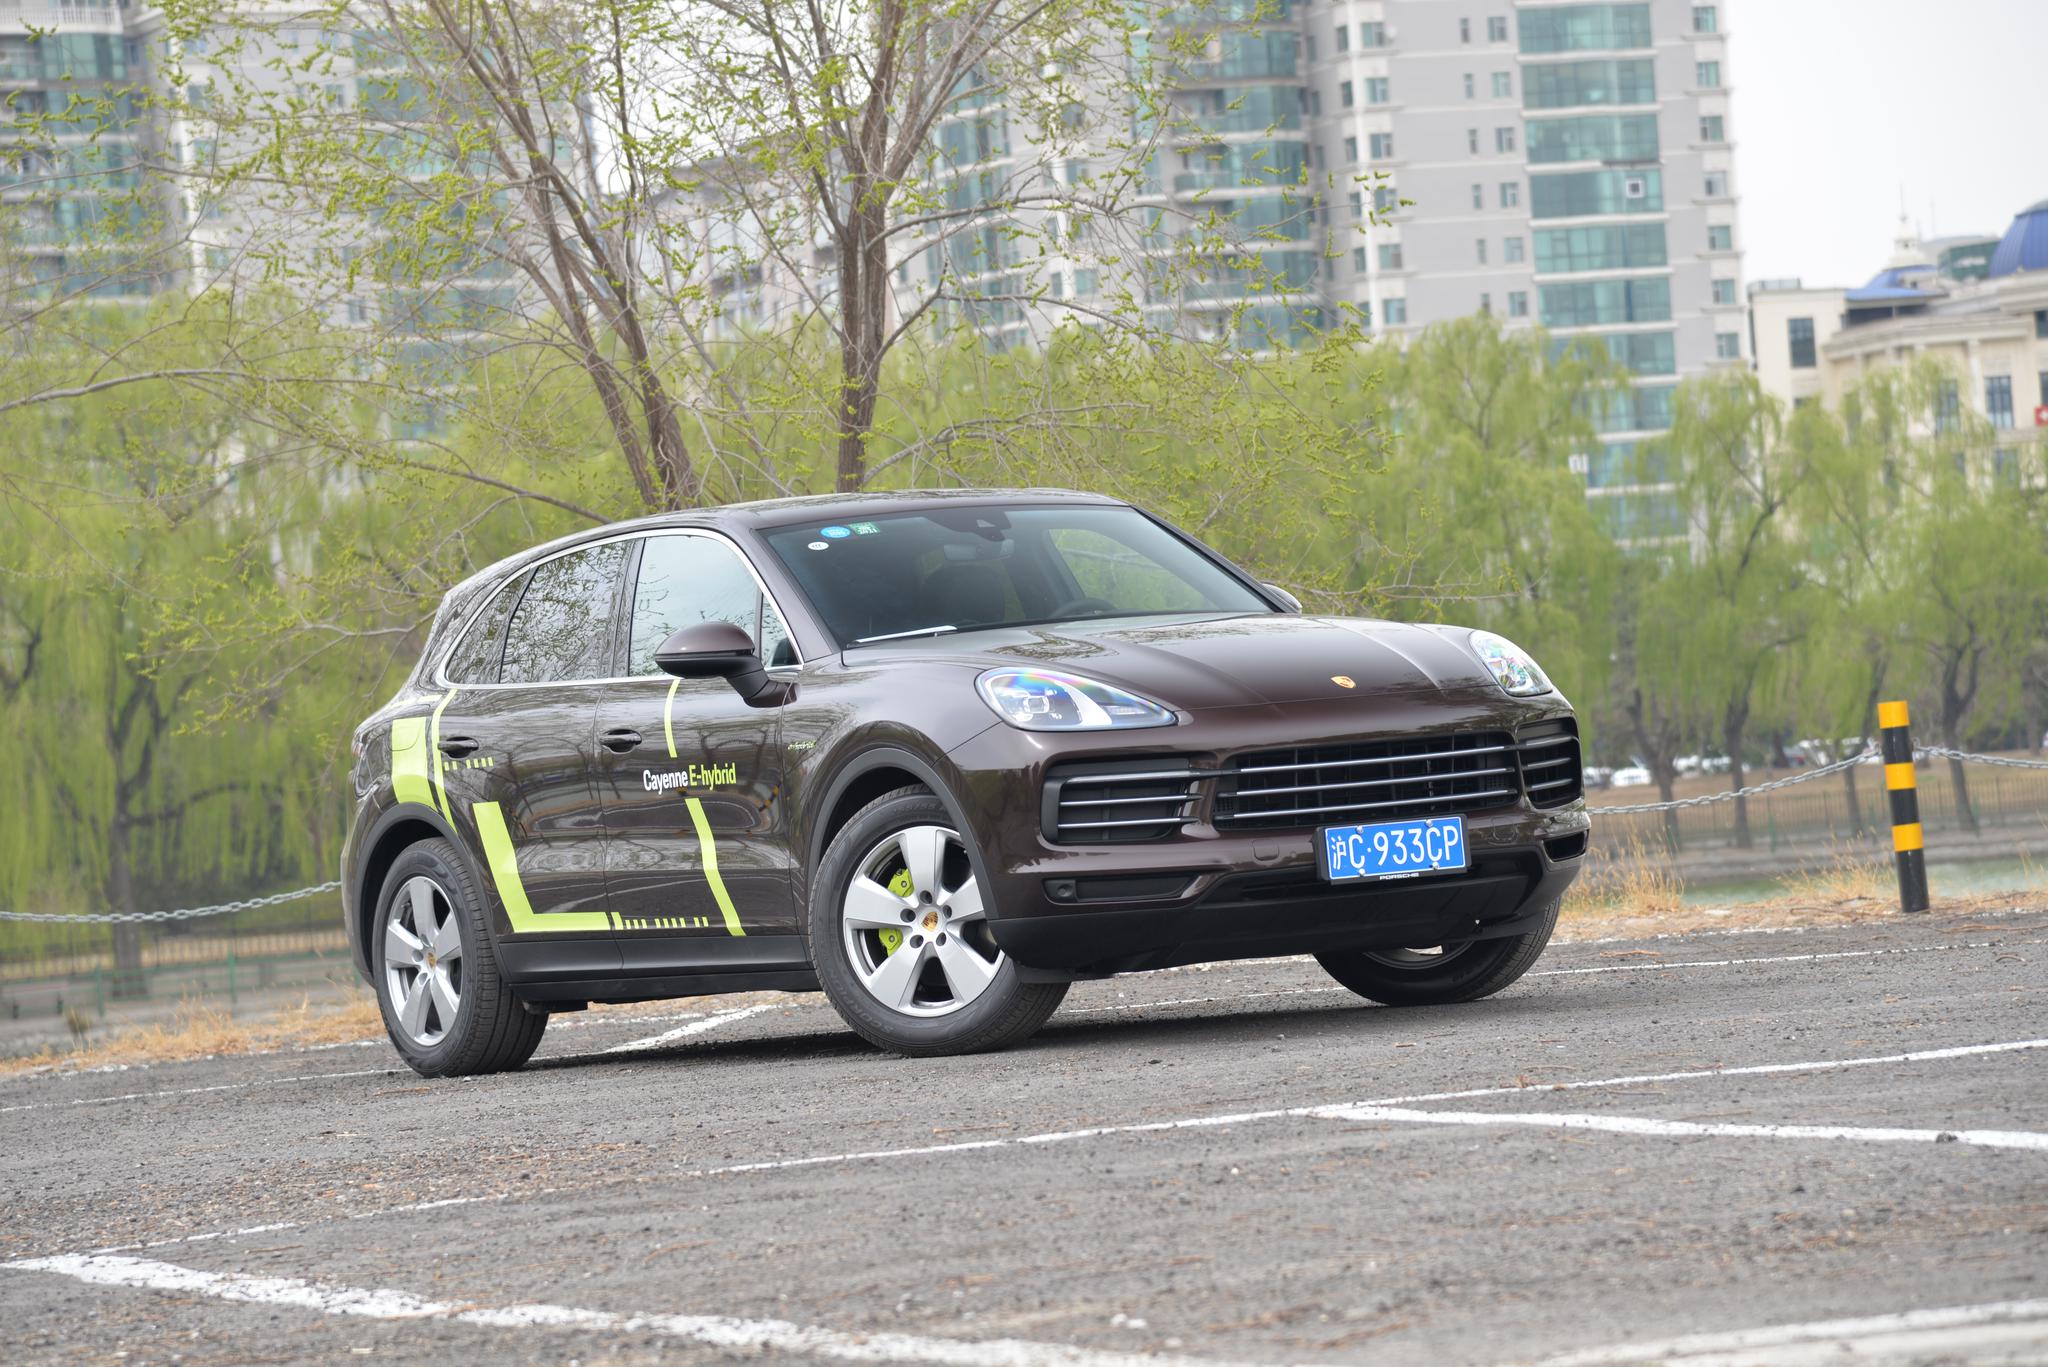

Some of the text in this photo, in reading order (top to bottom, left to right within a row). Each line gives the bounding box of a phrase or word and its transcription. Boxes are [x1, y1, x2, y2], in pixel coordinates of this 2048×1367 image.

[643, 762, 737, 795] Cayenne E-hybrid
[1379, 872, 1420, 881] PORSCHE
